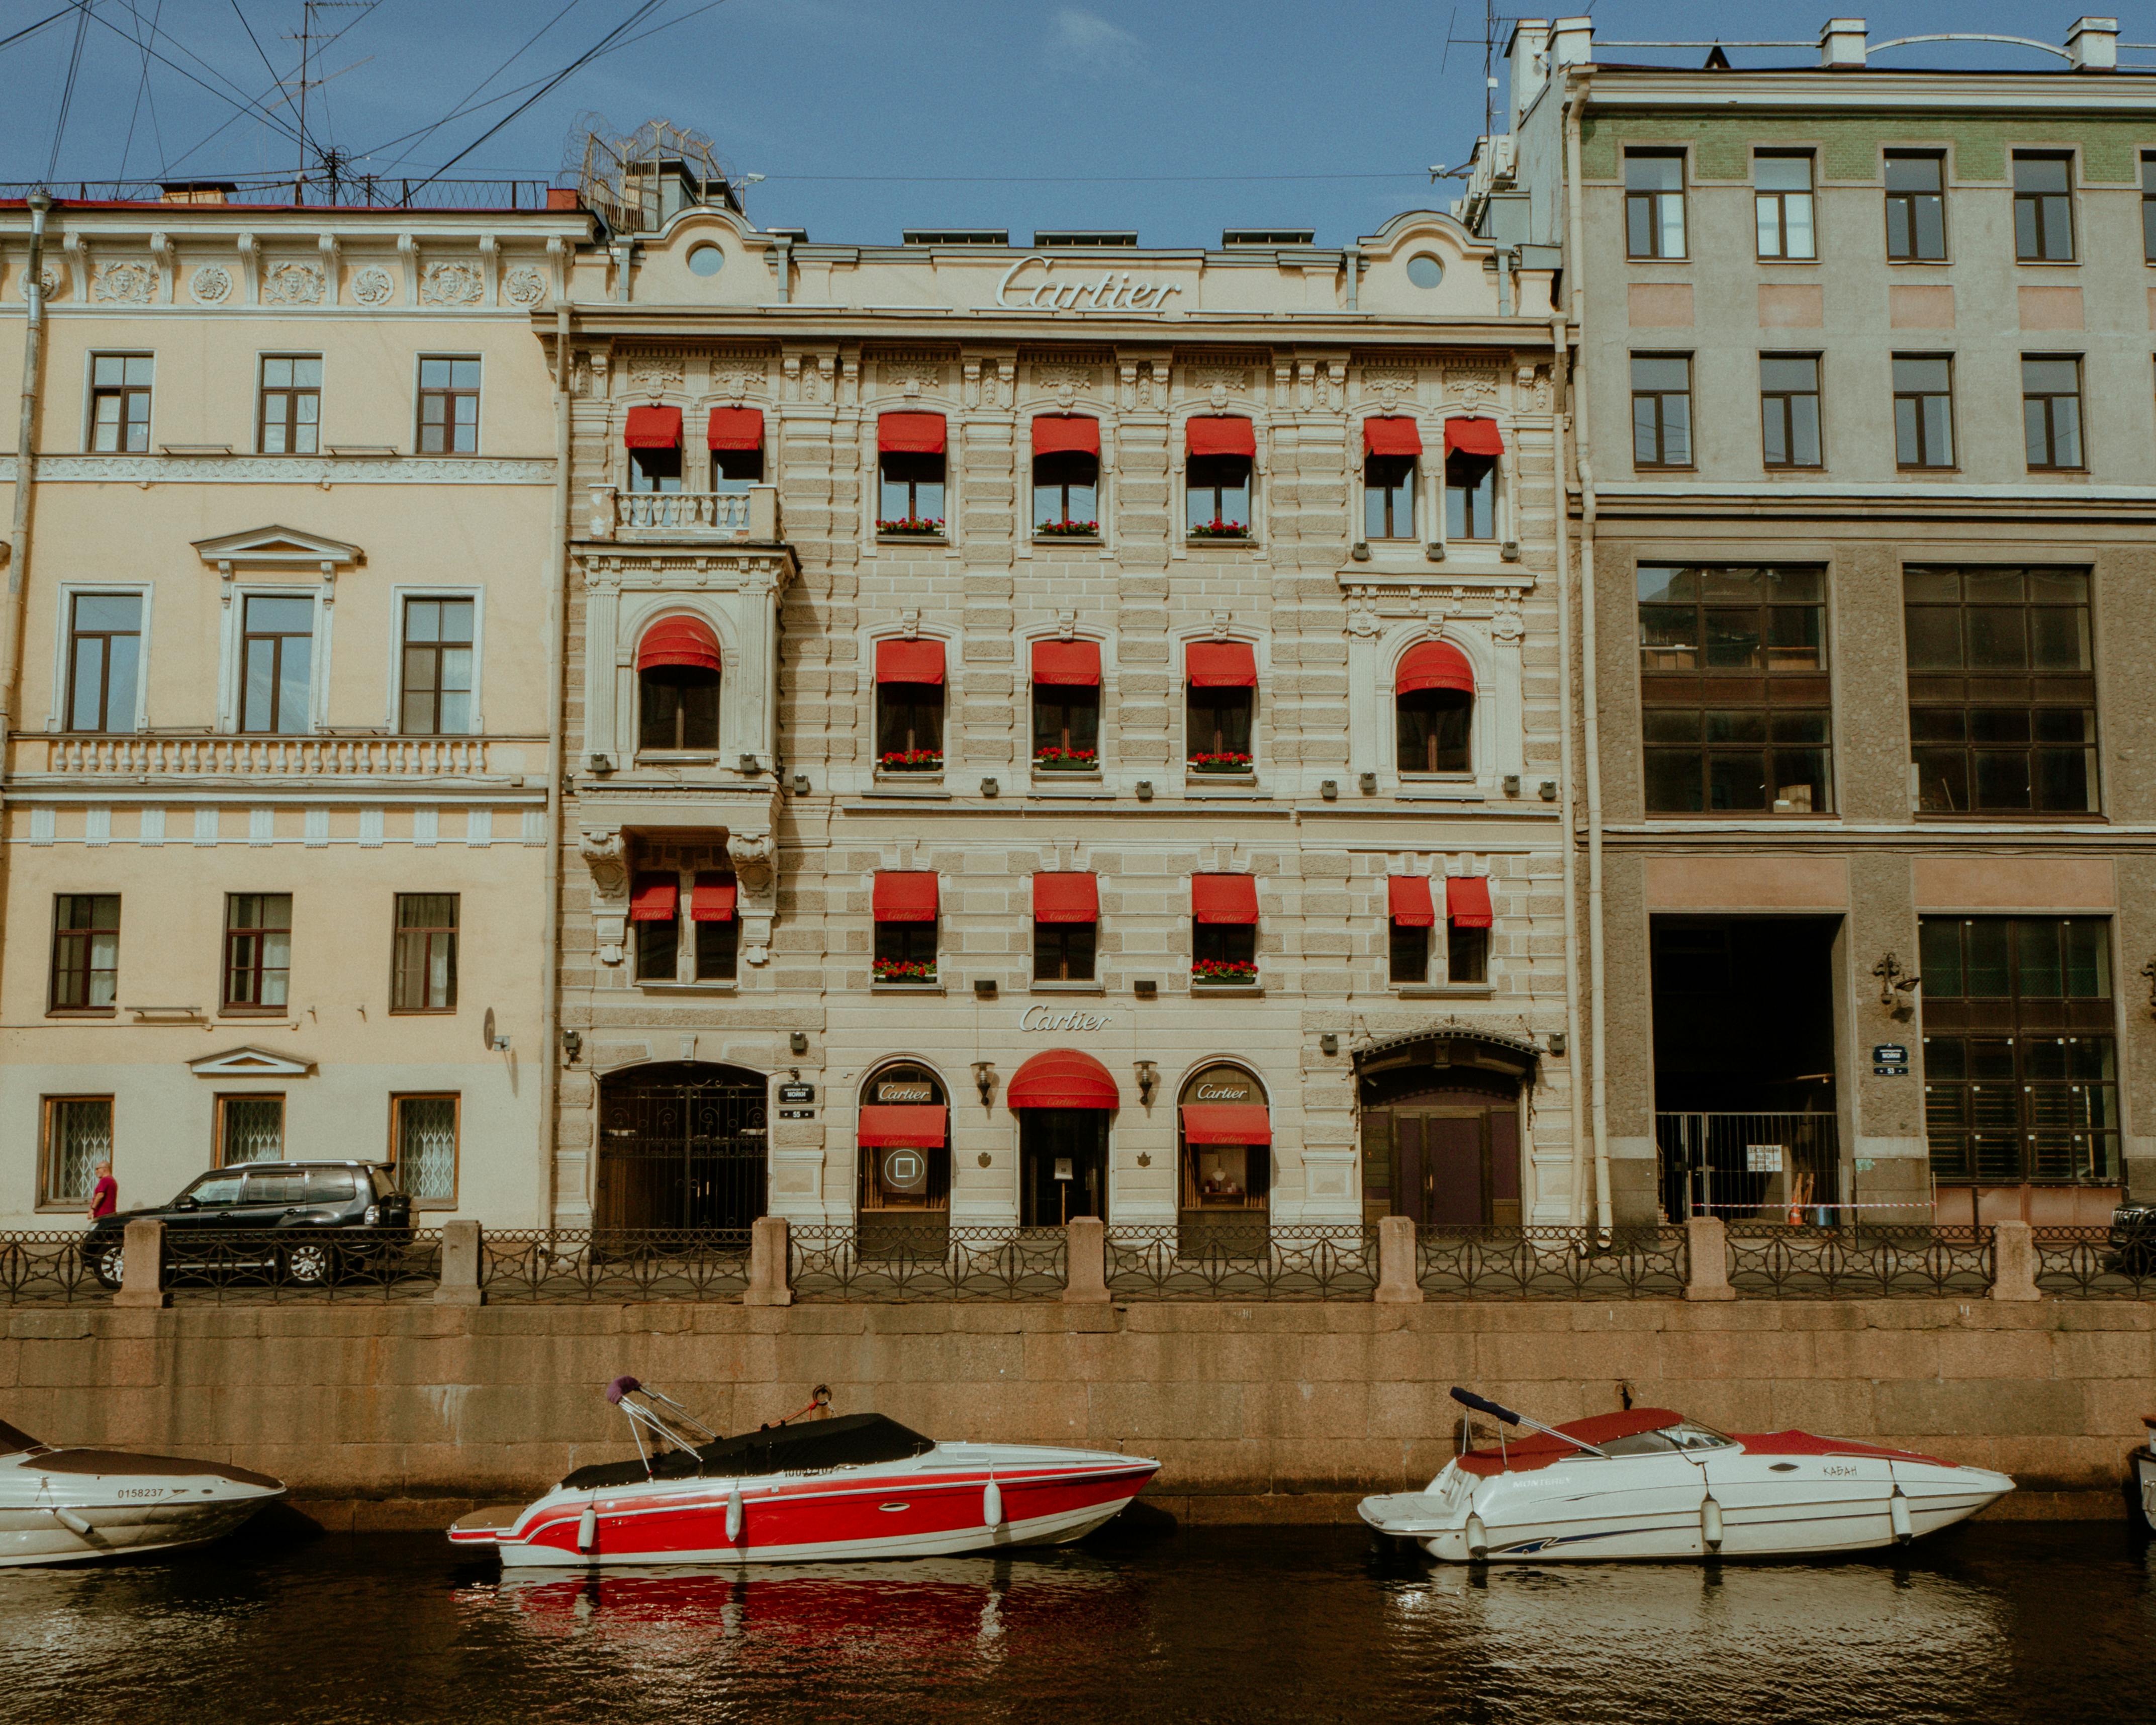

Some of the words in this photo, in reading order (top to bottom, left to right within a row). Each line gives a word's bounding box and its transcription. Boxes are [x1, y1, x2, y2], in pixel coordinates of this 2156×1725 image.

[995, 255, 1182, 309] Cartier
[633, 438, 667, 447] Cartier
[716, 439, 749, 448] Cartier
[894, 442, 926, 450] Cartier
[658, 655, 692, 663] Cartier
[1050, 674, 1082, 683] Cartier
[1208, 676, 1240, 685] Cartier
[1426, 677, 1457, 687] Cartier
[636, 909, 668, 919] Cartier
[695, 910, 728, 920] Cartier
[887, 911, 920, 920] Cartier
[1050, 912, 1082, 921] Cartier
[1212, 913, 1244, 922] Cartier
[1399, 916, 1430, 925] Cartier
[1456, 916, 1489, 926] Cartier
[1019, 1005, 1112, 1031] Cartier
[880, 1084, 930, 1100] Cartier
[1197, 1083, 1247, 1100] Cartier
[1047, 1098, 1080, 1106] Cartier
[883, 1137, 917, 1146] Cartier
[1212, 1133, 1246, 1143] Cartier
[1823, 1466, 1857, 1477] КАБАН
[1513, 1477, 1571, 1489] MONTEREY
[118, 1488, 164, 1498] 0158237
